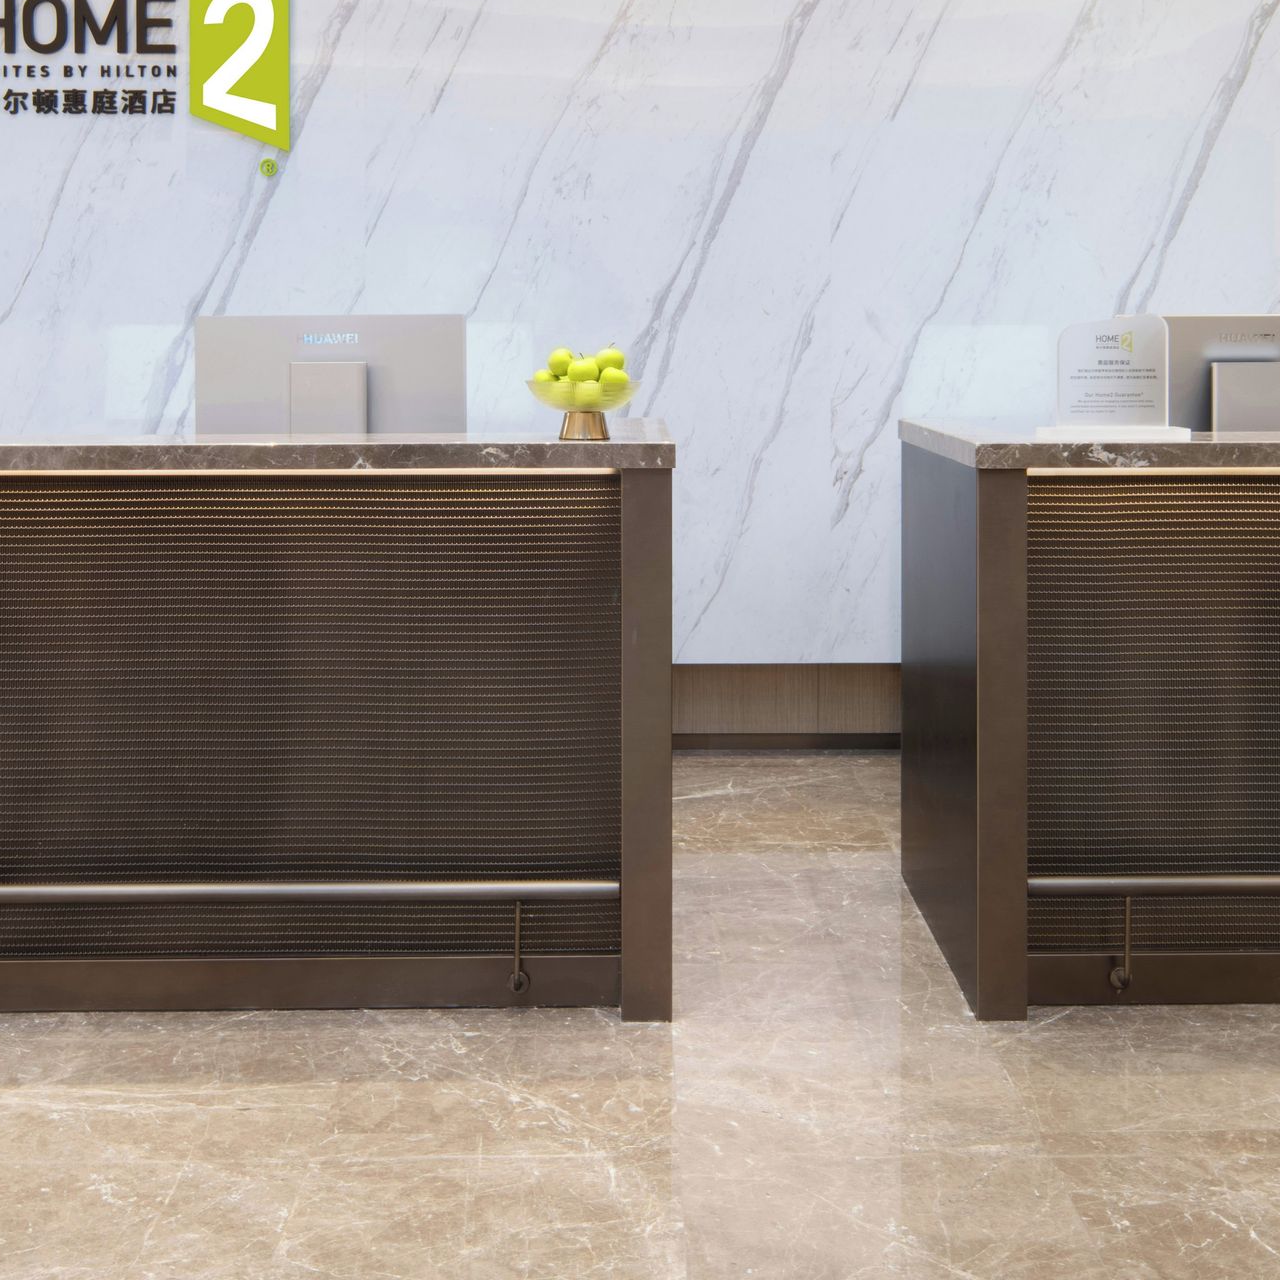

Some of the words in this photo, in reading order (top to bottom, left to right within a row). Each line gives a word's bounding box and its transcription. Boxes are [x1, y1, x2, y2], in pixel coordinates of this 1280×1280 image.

[63, 65, 89, 78] BY
[100, 65, 178, 78] HILTON
[303, 333, 359, 345] HUAWEI
[1096, 334, 1120, 343] HOME
